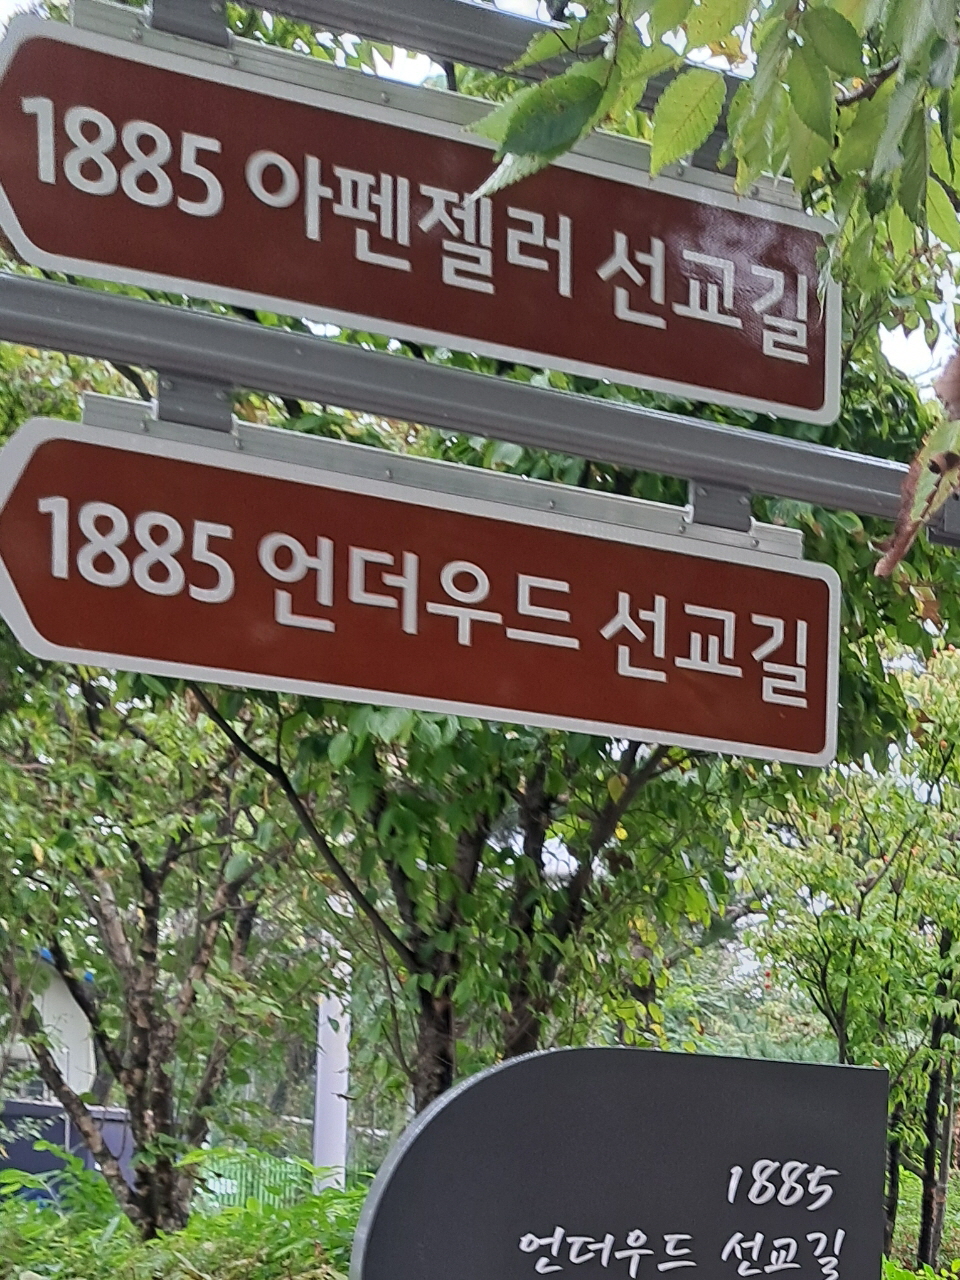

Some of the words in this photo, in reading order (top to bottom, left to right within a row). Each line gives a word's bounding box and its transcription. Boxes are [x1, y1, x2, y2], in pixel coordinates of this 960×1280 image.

[21, 96, 225, 217] 1885
[245, 149, 573, 298] 아펜젤러
[598, 232, 810, 365] 선교길
[37, 496, 236, 604] 1885
[257, 532, 580, 650] 언더우드
[601, 592, 809, 709] 선교길
[727, 1159, 841, 1211] 1885
[518, 1226, 698, 1279] 언더우드
